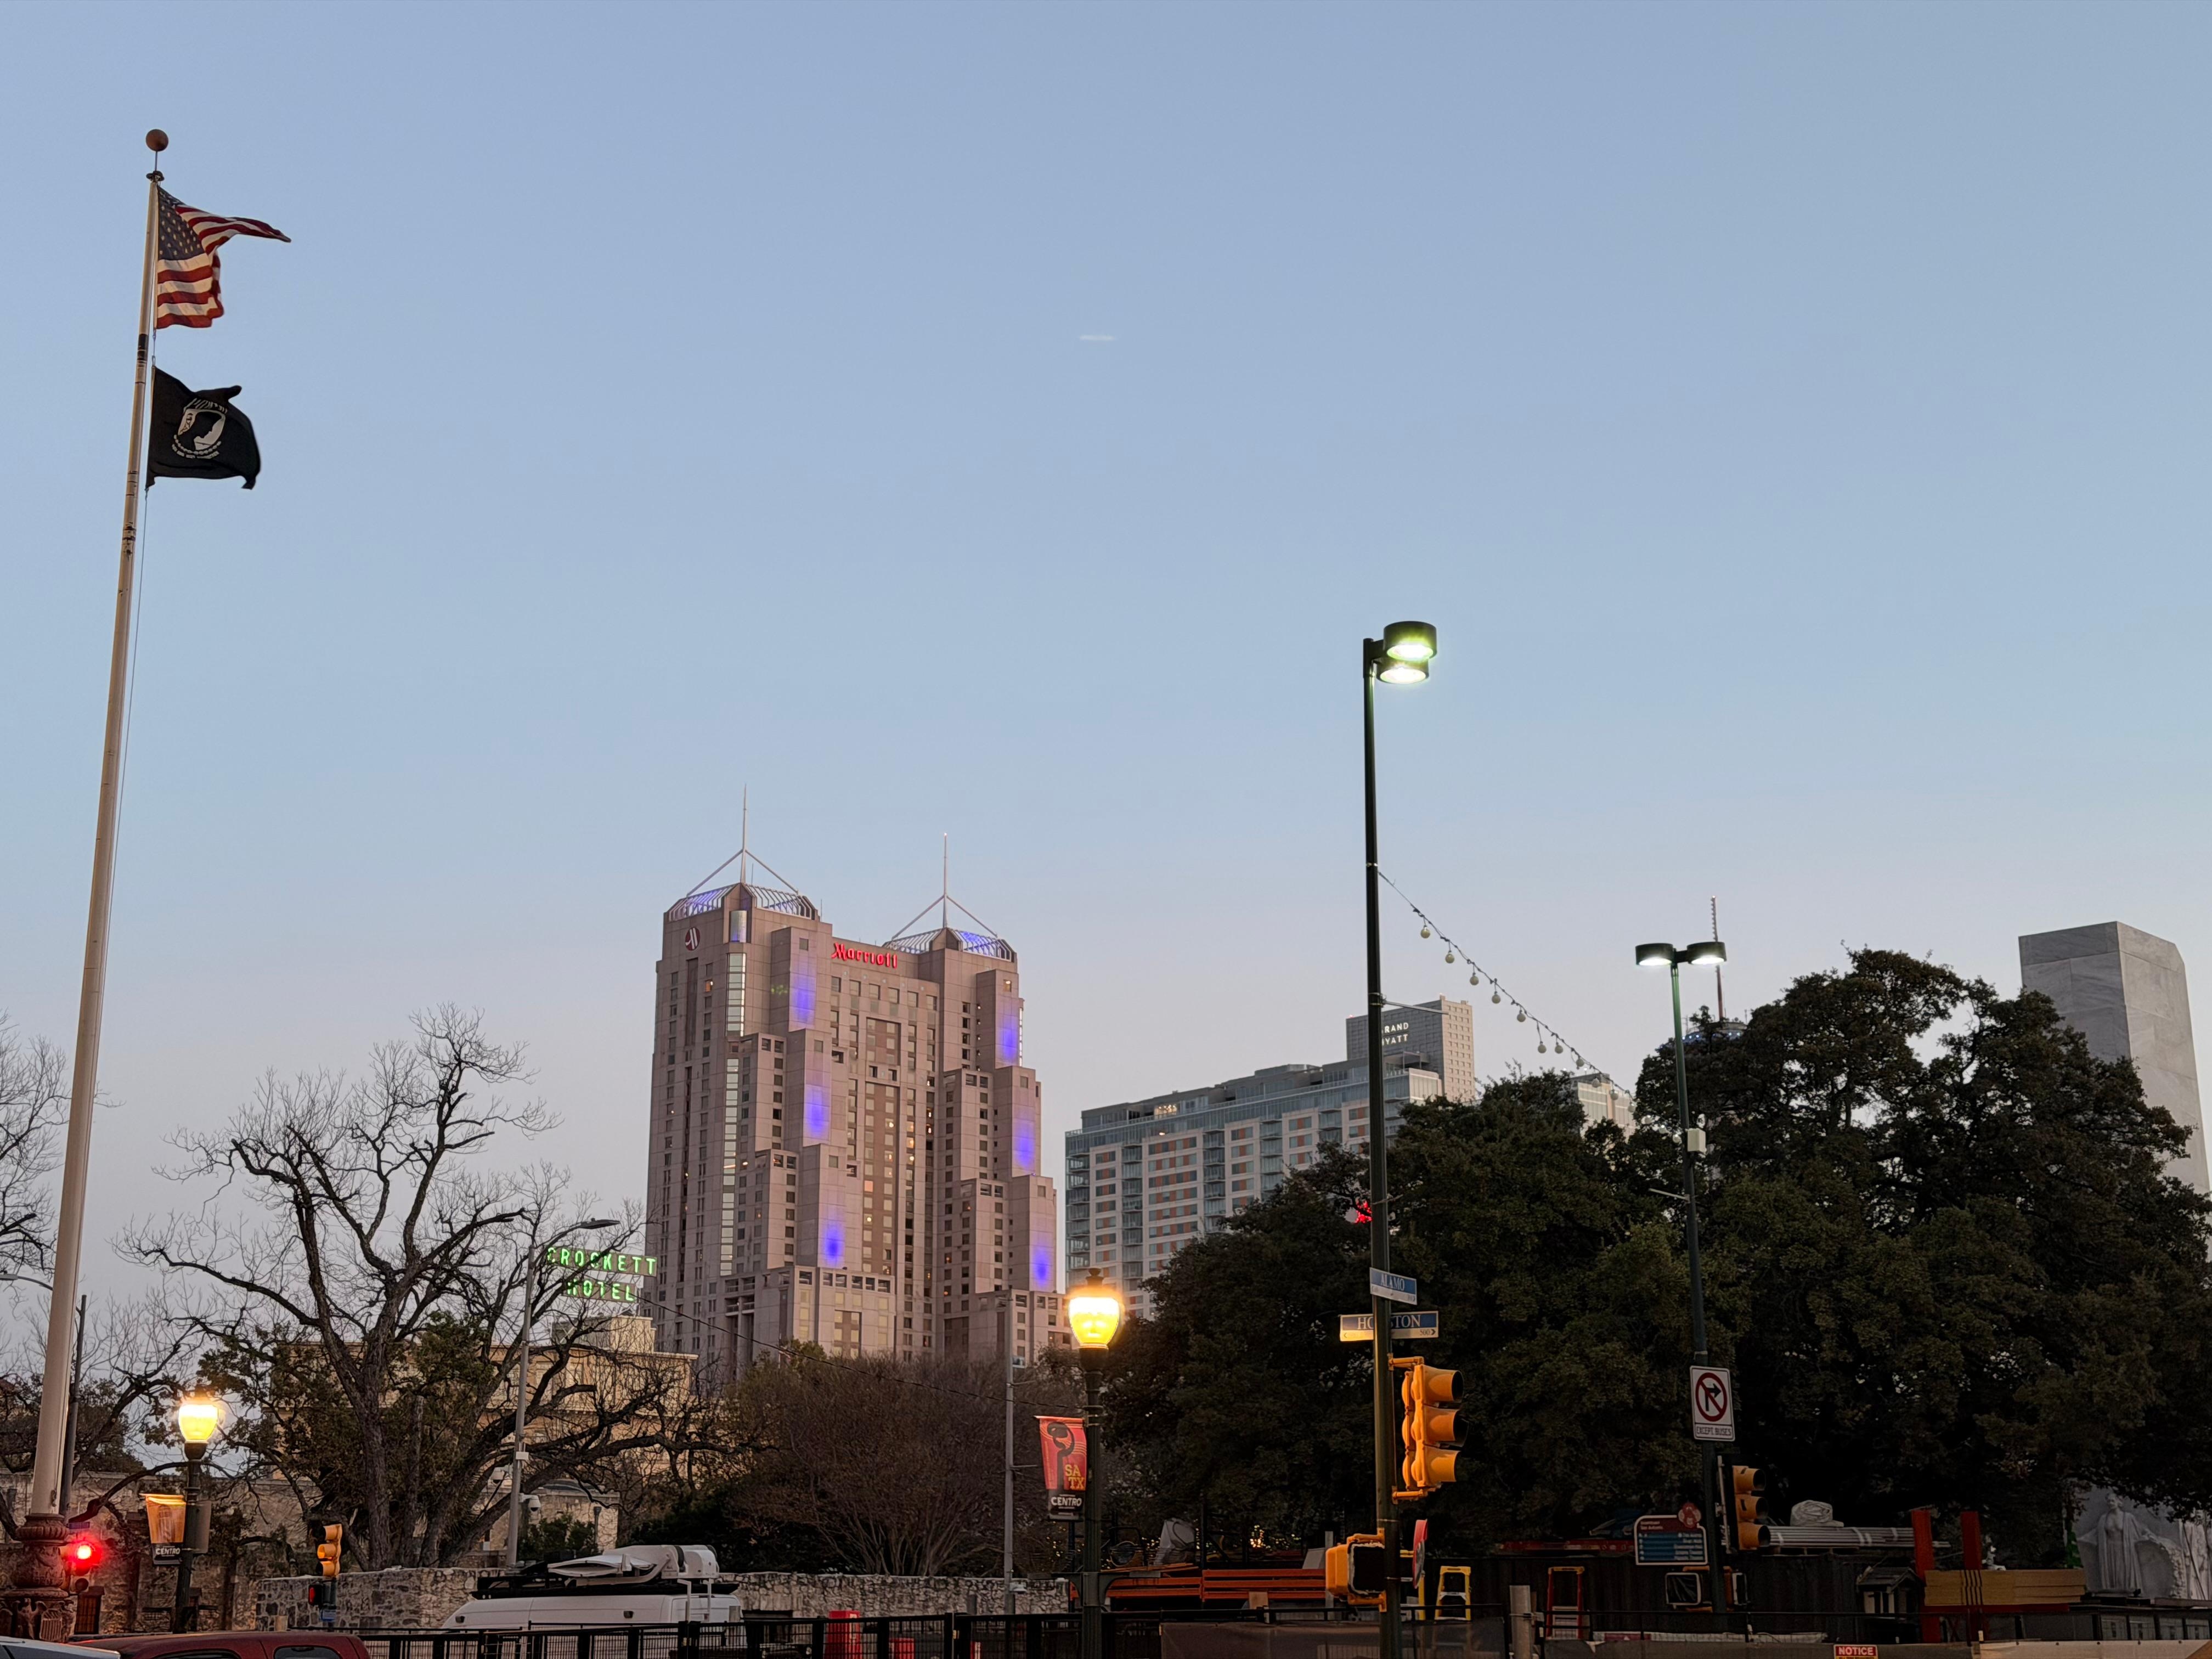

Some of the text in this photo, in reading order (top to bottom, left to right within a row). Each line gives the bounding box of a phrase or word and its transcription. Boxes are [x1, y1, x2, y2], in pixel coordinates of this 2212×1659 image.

[831, 942, 897, 969] Marriott
[1381, 1022, 1409, 1034] RAND
[548, 1247, 656, 1275] CROCKETT
[1380, 1273, 1405, 1291] ALAMO
[567, 1279, 635, 1301] HOTEL
[1357, 1314, 1421, 1330] HOTON
[1065, 1464, 1081, 1477] SA
[1069, 1477, 1086, 1489] TX
[1051, 1496, 1082, 1507] CENTRO
[155, 1547, 181, 1555] CENTRO
[1838, 1646, 1874, 1656] NOTICE
